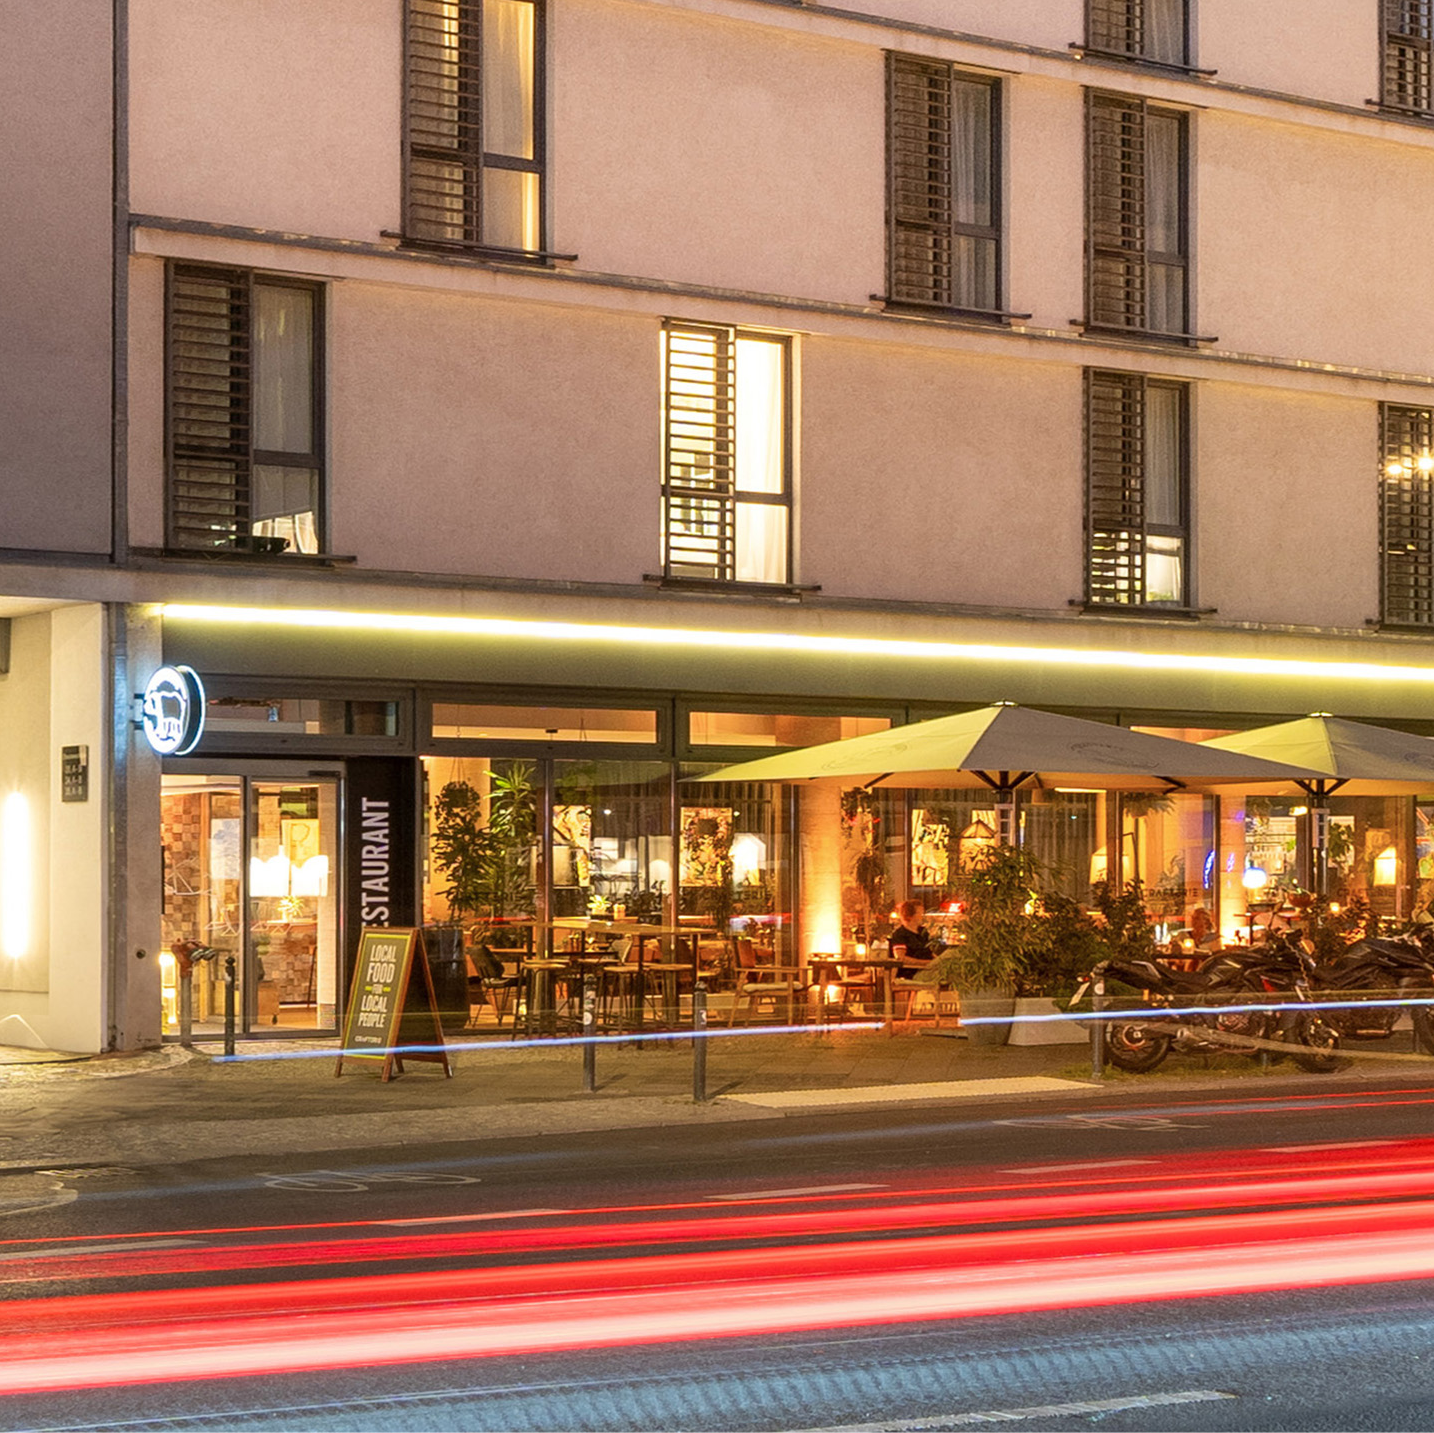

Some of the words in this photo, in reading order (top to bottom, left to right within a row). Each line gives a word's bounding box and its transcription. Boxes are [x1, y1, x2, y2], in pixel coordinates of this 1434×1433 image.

[361, 797, 389, 927] STAURANT
[370, 945, 397, 962] LOCAL
[366, 963, 396, 983] FOOD
[361, 995, 388, 1013] LOCAL
[358, 1012, 387, 1028] PEOPLE
